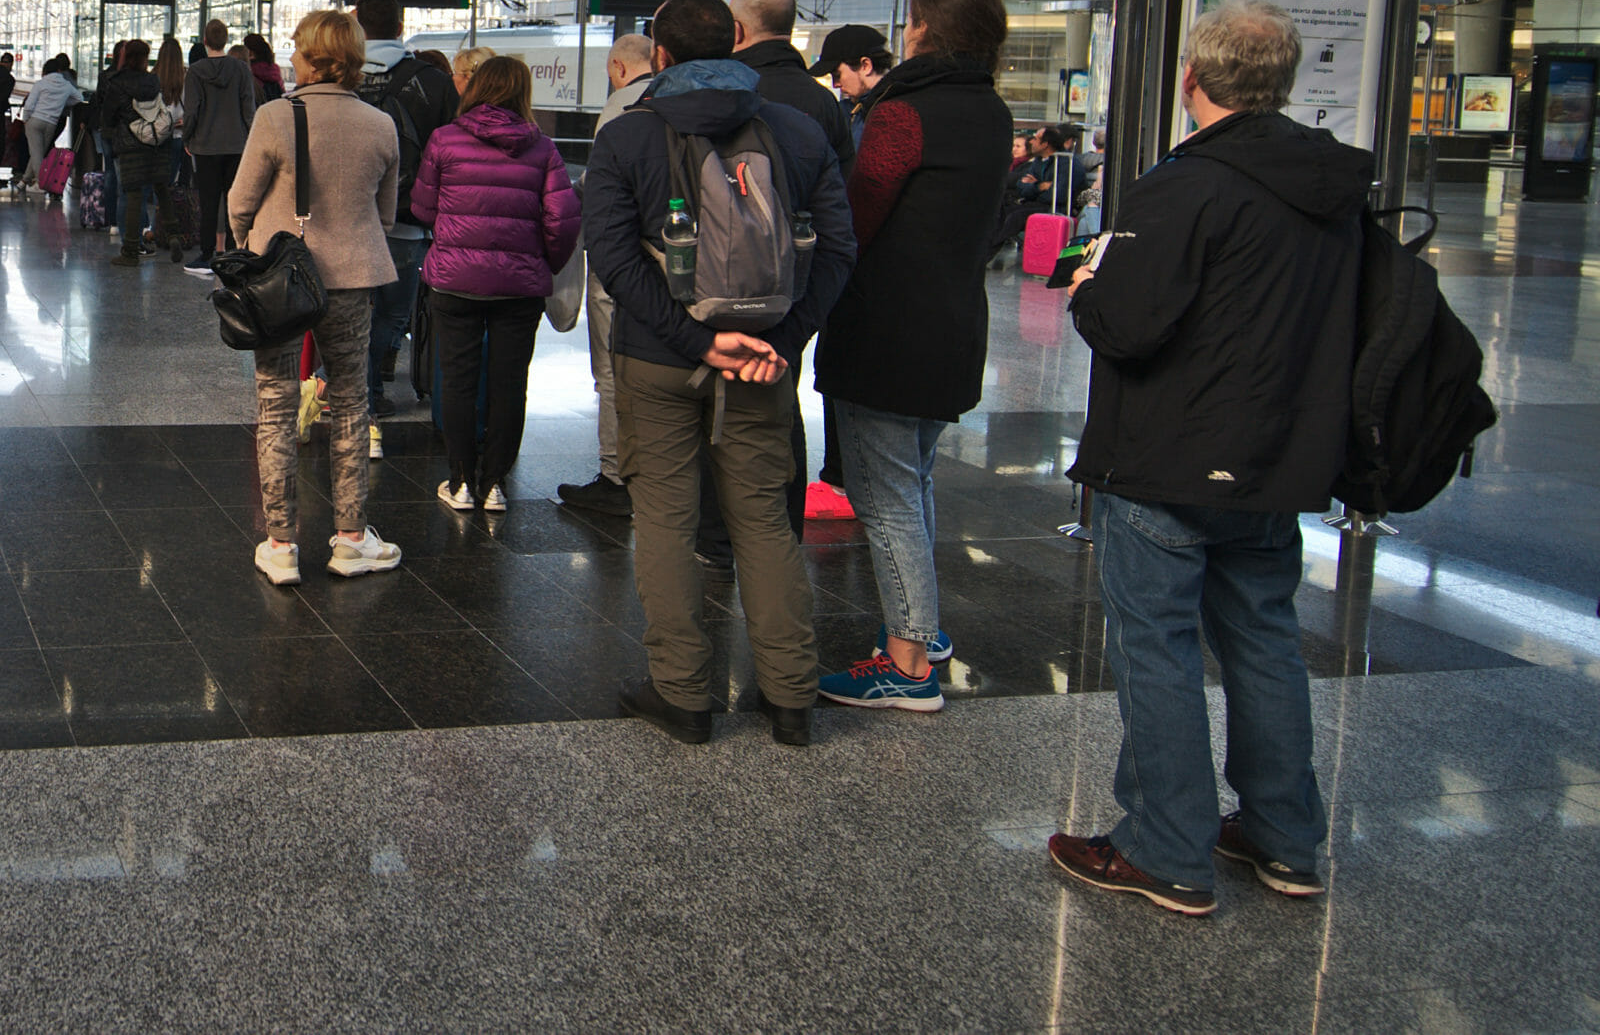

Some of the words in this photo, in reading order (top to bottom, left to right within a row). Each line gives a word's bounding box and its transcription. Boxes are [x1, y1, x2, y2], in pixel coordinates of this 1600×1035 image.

[1337, 8, 1352, 17] 5:00
[531, 55, 567, 87] renfe
[555, 82, 577, 101] AVE
